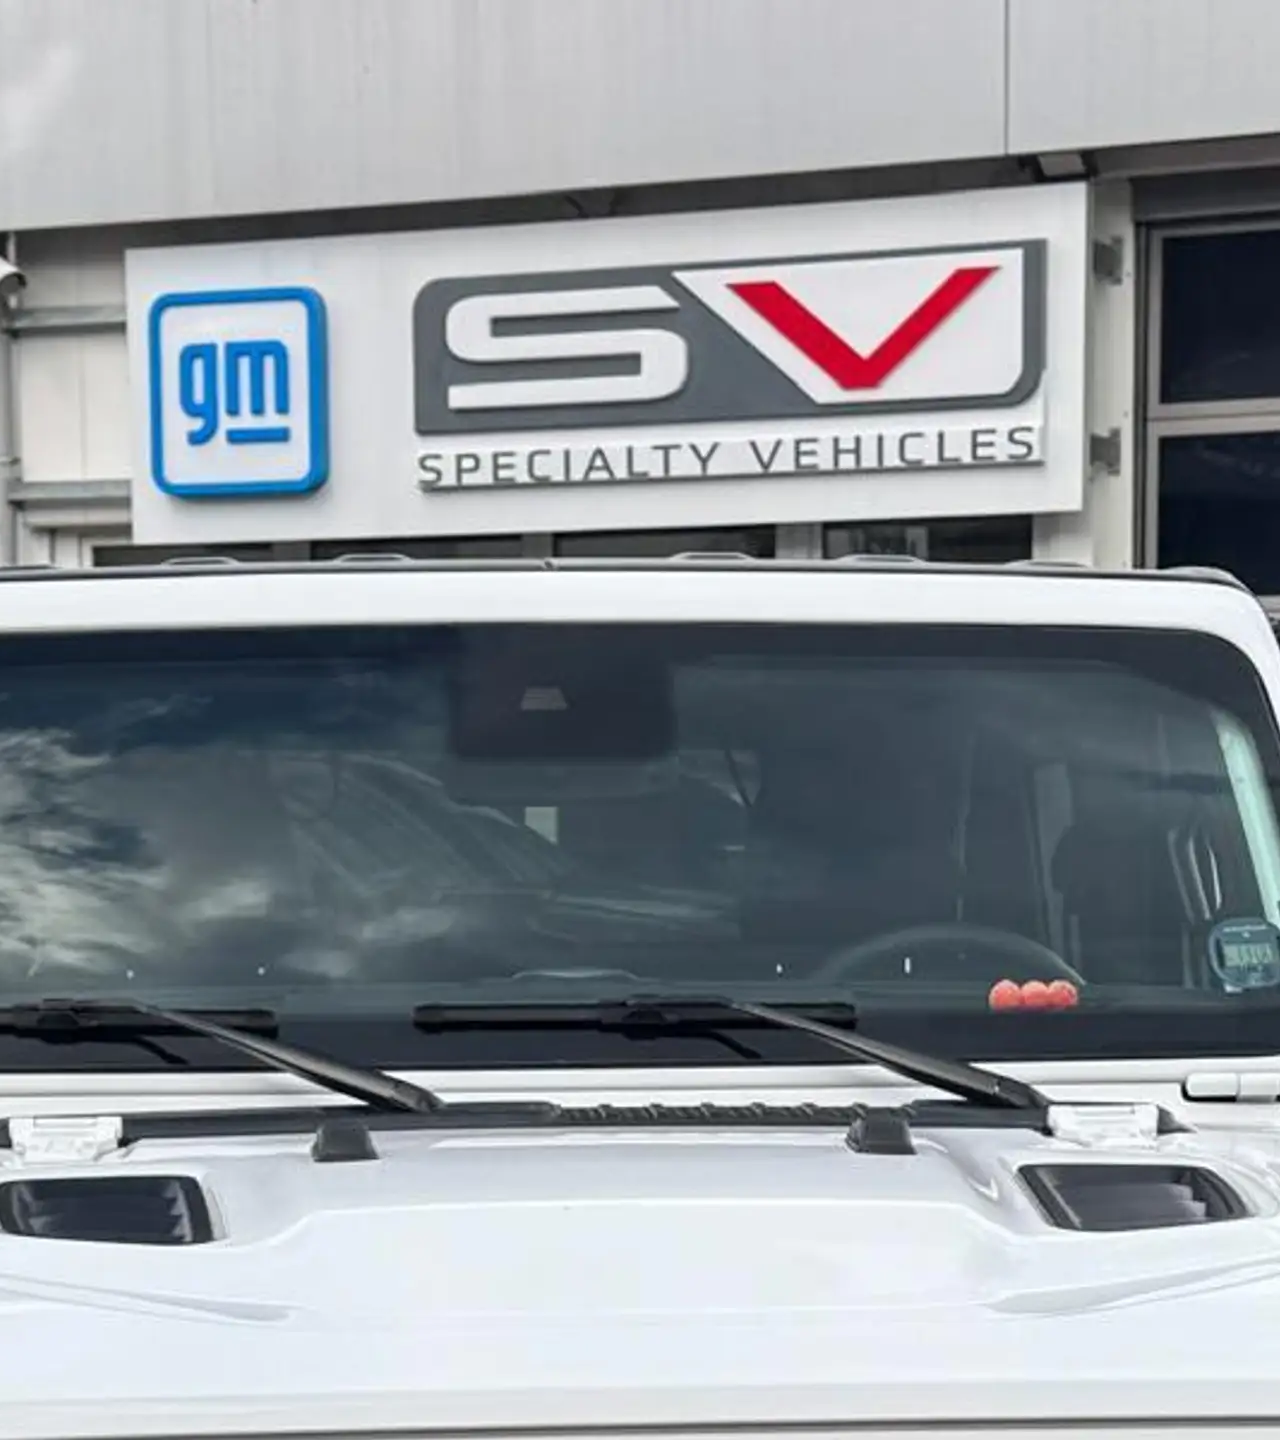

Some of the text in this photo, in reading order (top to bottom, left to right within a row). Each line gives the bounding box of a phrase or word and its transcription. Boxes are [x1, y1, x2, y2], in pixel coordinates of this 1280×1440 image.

[177, 338, 289, 446] gm
[417, 424, 1036, 489] SPECIALTY VEHICLES
